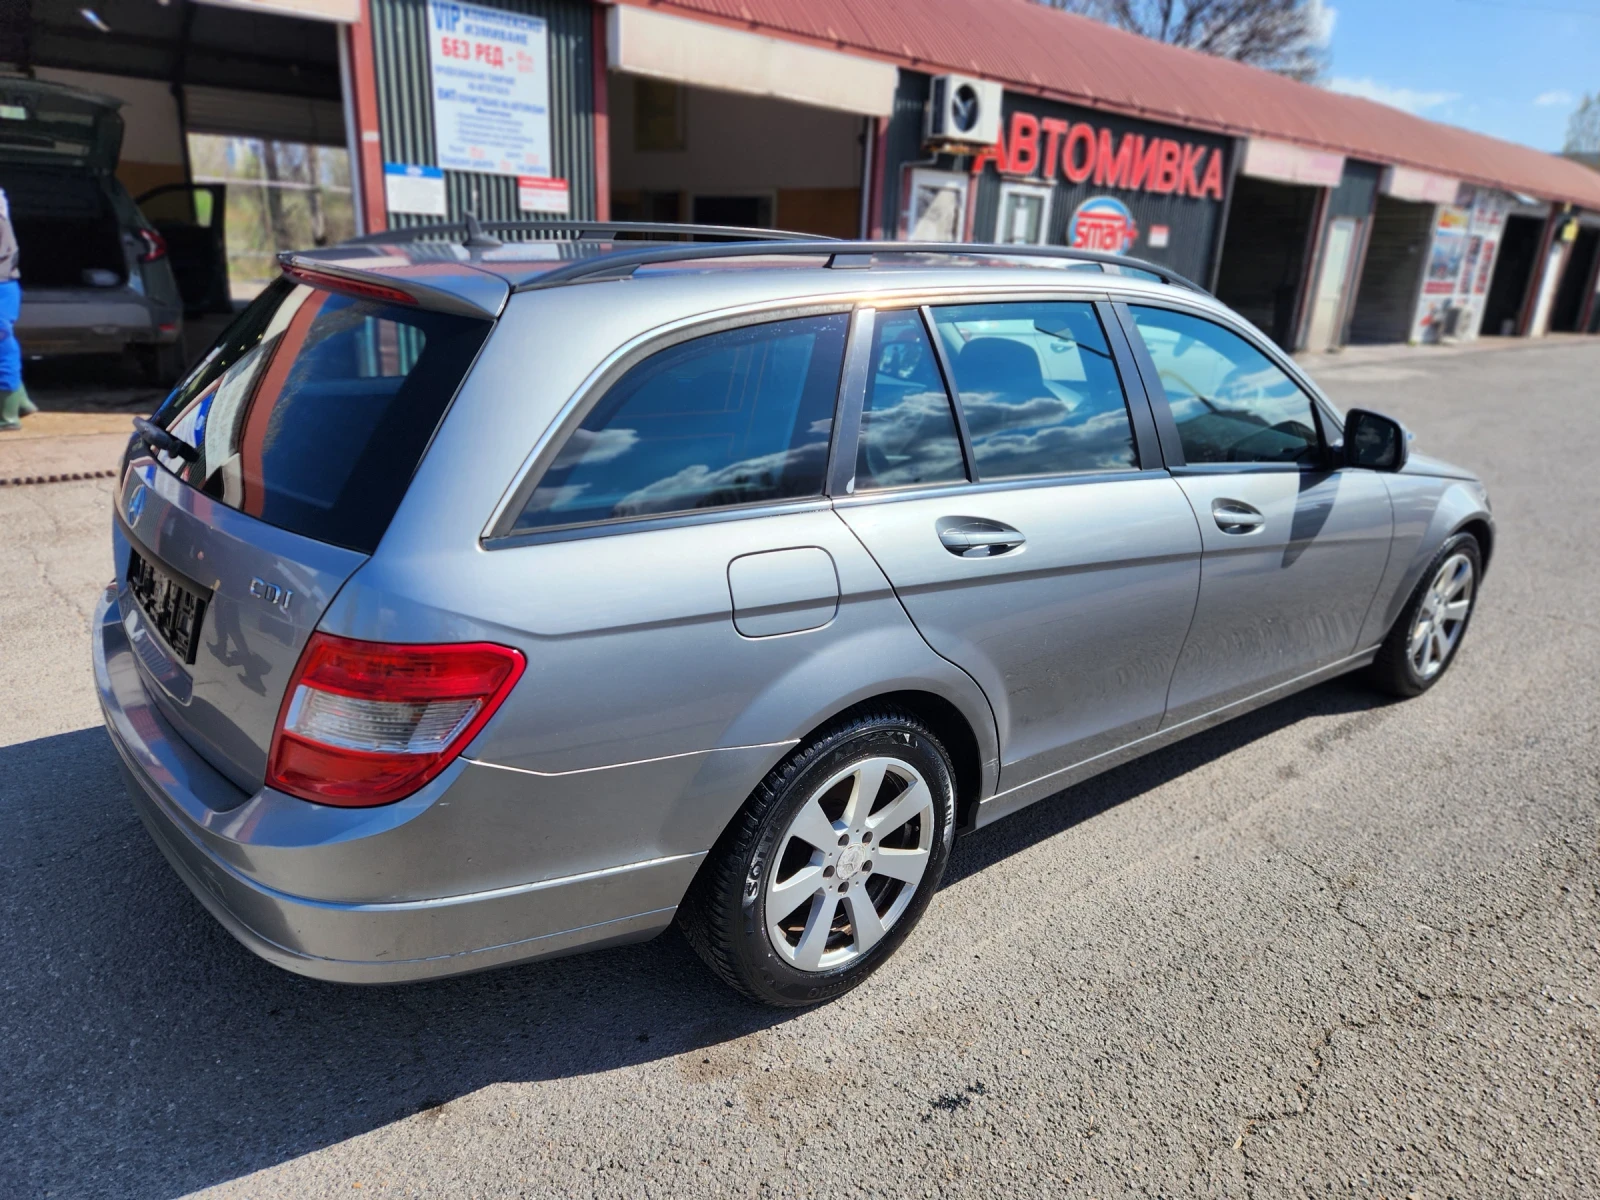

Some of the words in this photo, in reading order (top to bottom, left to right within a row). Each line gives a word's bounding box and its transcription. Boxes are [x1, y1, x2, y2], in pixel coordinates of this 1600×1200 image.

[433, 2, 461, 33] VIP
[441, 37, 470, 60] БЕЗ
[475, 42, 505, 68] РЕД
[250, 576, 293, 608] CDI
